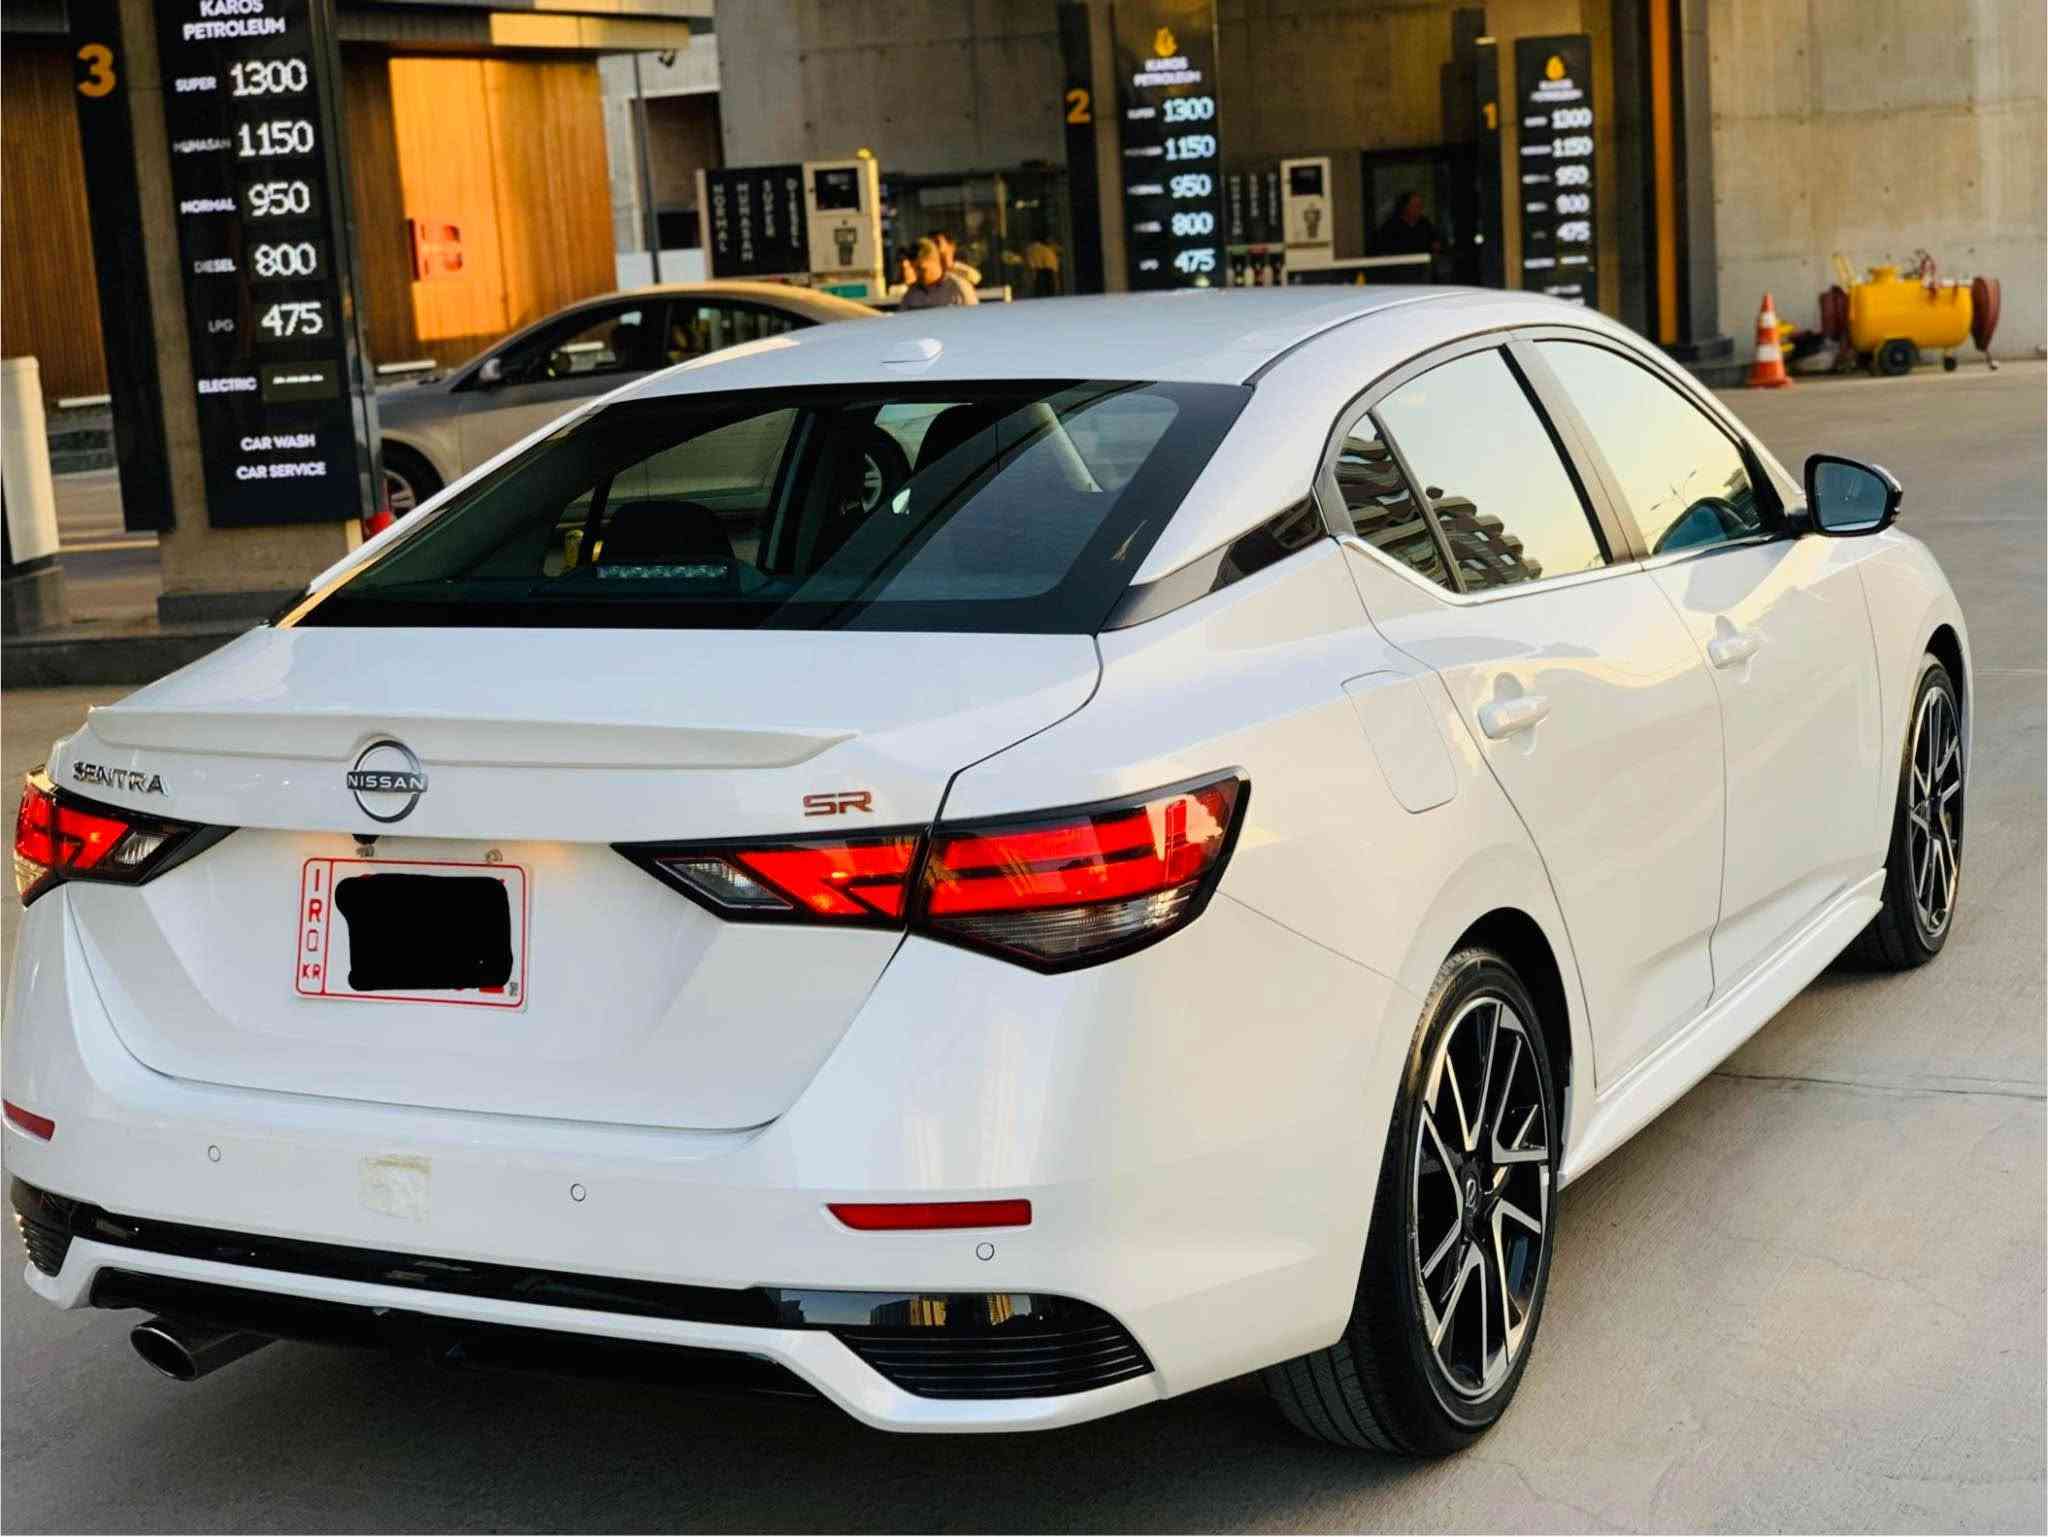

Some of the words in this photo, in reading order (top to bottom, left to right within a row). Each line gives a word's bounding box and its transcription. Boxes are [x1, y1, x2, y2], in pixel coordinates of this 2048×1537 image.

[200, 0, 264, 17] KAROS
[183, 17, 286, 41] PETROLEUM
[77, 43, 116, 97] 3
[175, 76, 217, 92] SUPER
[230, 58, 308, 97] 1300
[1066, 89, 1091, 124] 2
[1163, 96, 1215, 123] 1300
[238, 120, 314, 157] 1150
[1165, 134, 1217, 161] 1150
[180, 198, 237, 214] NORMAL
[248, 181, 310, 217] 950
[1170, 173, 1212, 199] 950
[1171, 211, 1214, 236] 800
[194, 258, 237, 274] DIESEL
[254, 242, 317, 277] 800
[1174, 248, 1216, 273] 475
[208, 318, 235, 334] LPG
[261, 301, 324, 337] 475
[198, 376, 257, 394] ELECTRIC
[240, 436, 272, 452] CAR
[273, 433, 316, 449] WASH
[236, 465, 268, 480] CAR
[269, 460, 327, 478] SERVICE
[73, 761, 168, 796] SENTRA
[348, 772, 425, 791] NISSAN
[803, 791, 873, 816] SR
[302, 963, 321, 979] KR
